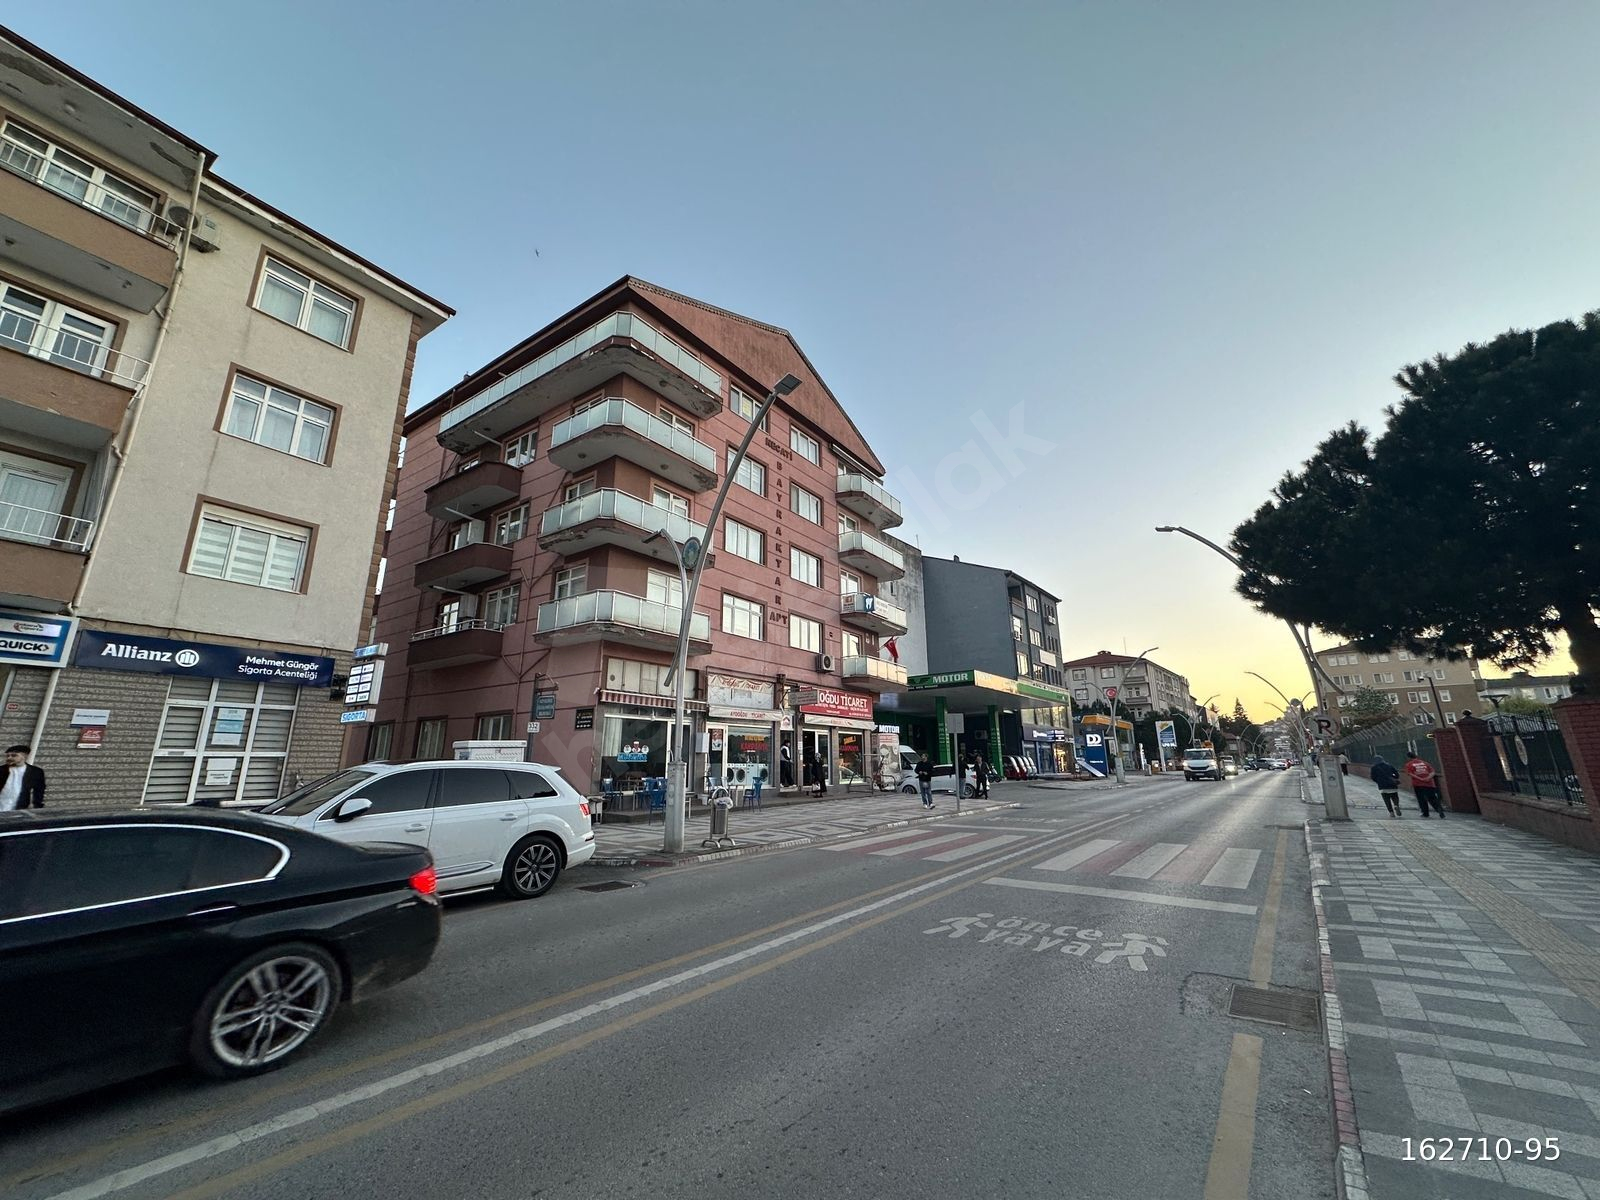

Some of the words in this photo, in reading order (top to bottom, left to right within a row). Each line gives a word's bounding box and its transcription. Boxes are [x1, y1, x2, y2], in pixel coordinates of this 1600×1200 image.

[765, 437, 793, 461] NECATİ
[769, 611, 788, 625] APT
[0, 639, 43, 651] QUICK
[101, 643, 173, 662] Allianz
[245, 656, 285, 667] Mehmet
[286, 660, 319, 671] Güngör
[238, 664, 273, 675] Sigorta
[274, 668, 318, 680] Acenteliği
[932, 673, 969, 684] MOTOR
[840, 693, 868, 709] TİCARET
[878, 724, 900, 733] MOTOR
[996, 915, 1104, 941] önce
[977, 928, 1092, 957] yaya
